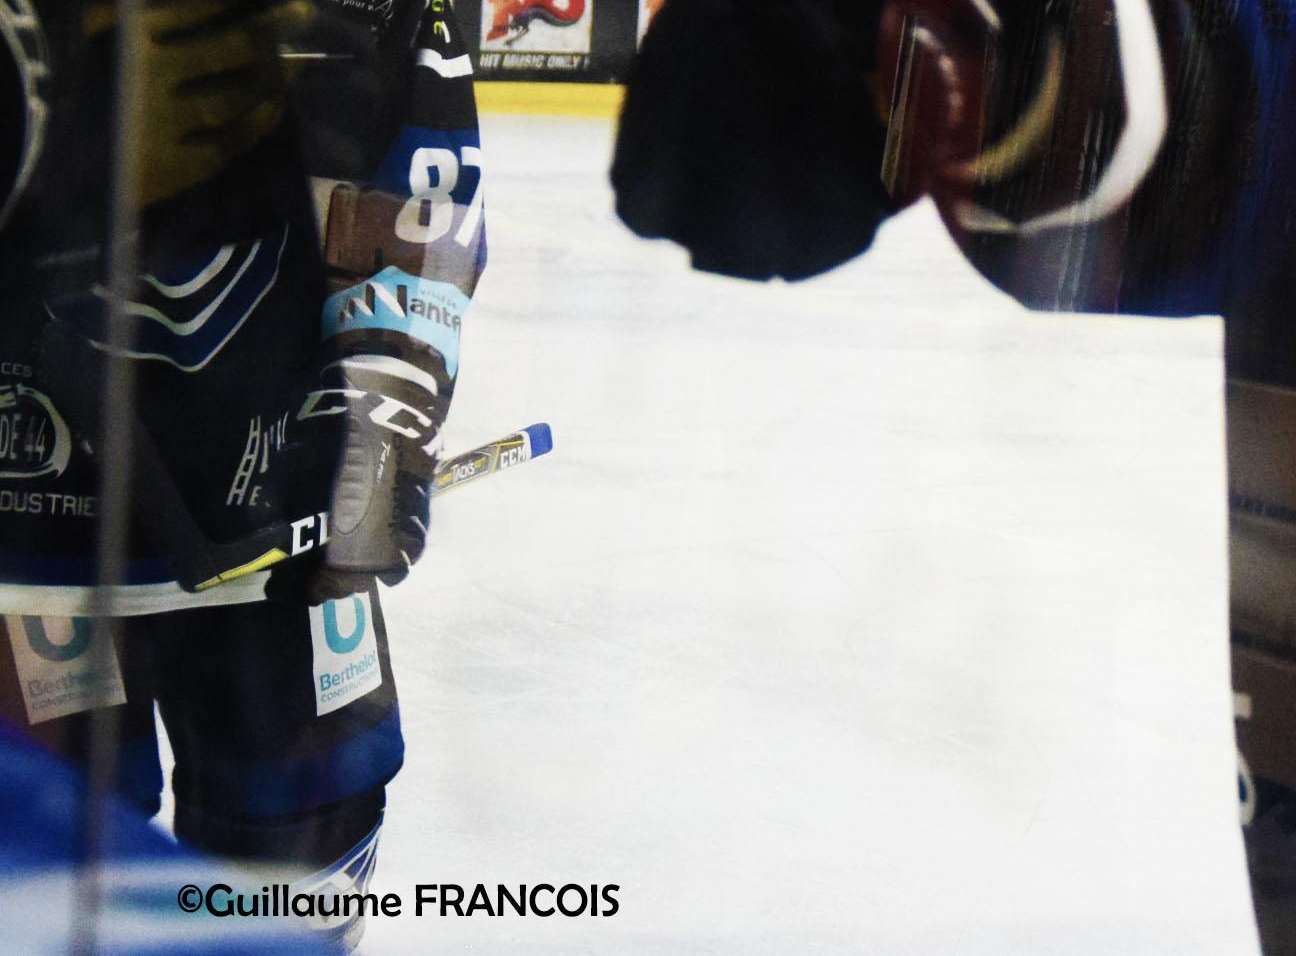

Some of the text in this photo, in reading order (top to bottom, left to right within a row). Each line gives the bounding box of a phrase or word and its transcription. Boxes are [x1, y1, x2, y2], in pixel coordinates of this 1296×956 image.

[502, 52, 545, 68] MUSIC
[394, 146, 484, 247] 87
[1, 362, 33, 378] CES
